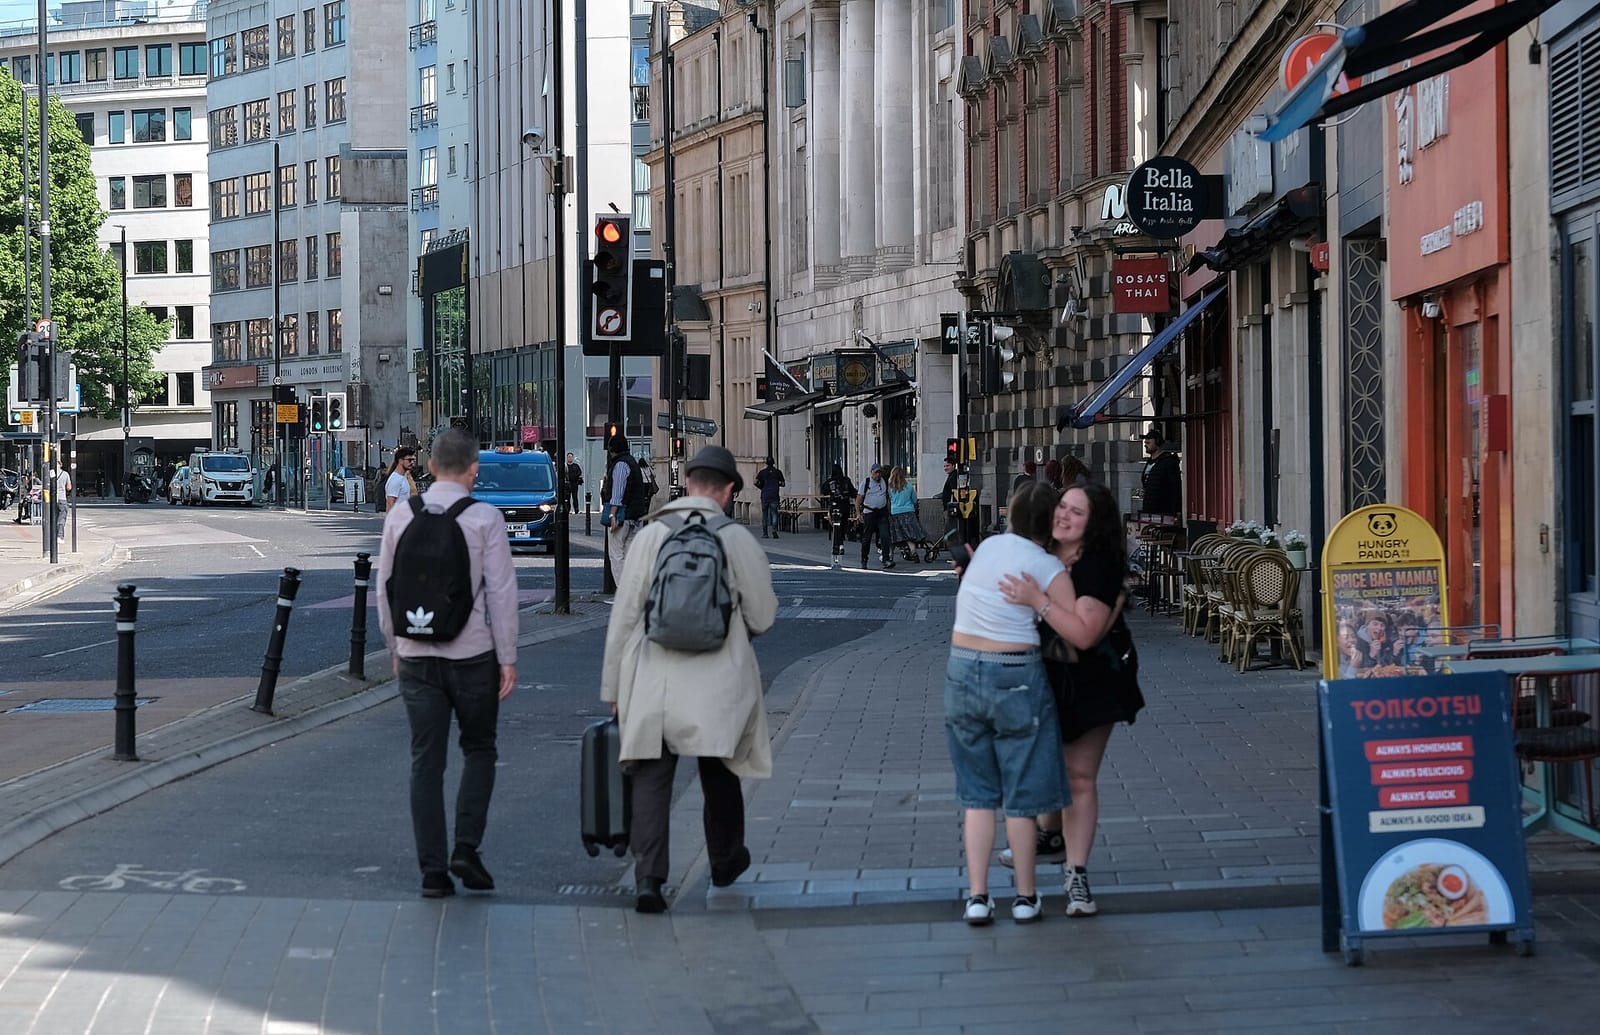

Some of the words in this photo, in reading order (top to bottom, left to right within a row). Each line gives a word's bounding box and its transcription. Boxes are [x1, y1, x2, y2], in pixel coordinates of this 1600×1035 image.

[1144, 167, 1193, 189] Bella
[1143, 191, 1193, 212] Italia
[1116, 274, 1166, 284] ROSA'S
[1125, 288, 1158, 298] THAI
[300, 367, 318, 375] LONDON
[323, 365, 343, 374] BUILDING
[1358, 539, 1409, 549] HUNGRY
[1359, 550, 1400, 559] PANDA
[1333, 573, 1367, 588] SPICE
[1370, 572, 1393, 587] BAG
[1395, 569, 1438, 585] MANIA!
[1350, 694, 1482, 720] TONKOTSU
[1375, 744, 1411, 755] ALWAYS
[1412, 742, 1464, 753] HOMEMADE
[1381, 768, 1416, 779] ALWAYS
[1417, 765, 1464, 777] DELICIOUS
[1390, 791, 1425, 802] ALWAYS
[1426, 789, 1456, 800] QUICK
[1380, 815, 1414, 826] ALWAYS
[1416, 815, 1423, 824] A
[1424, 814, 1450, 824] GOOD
[1452, 813, 1473, 823] IDEA
